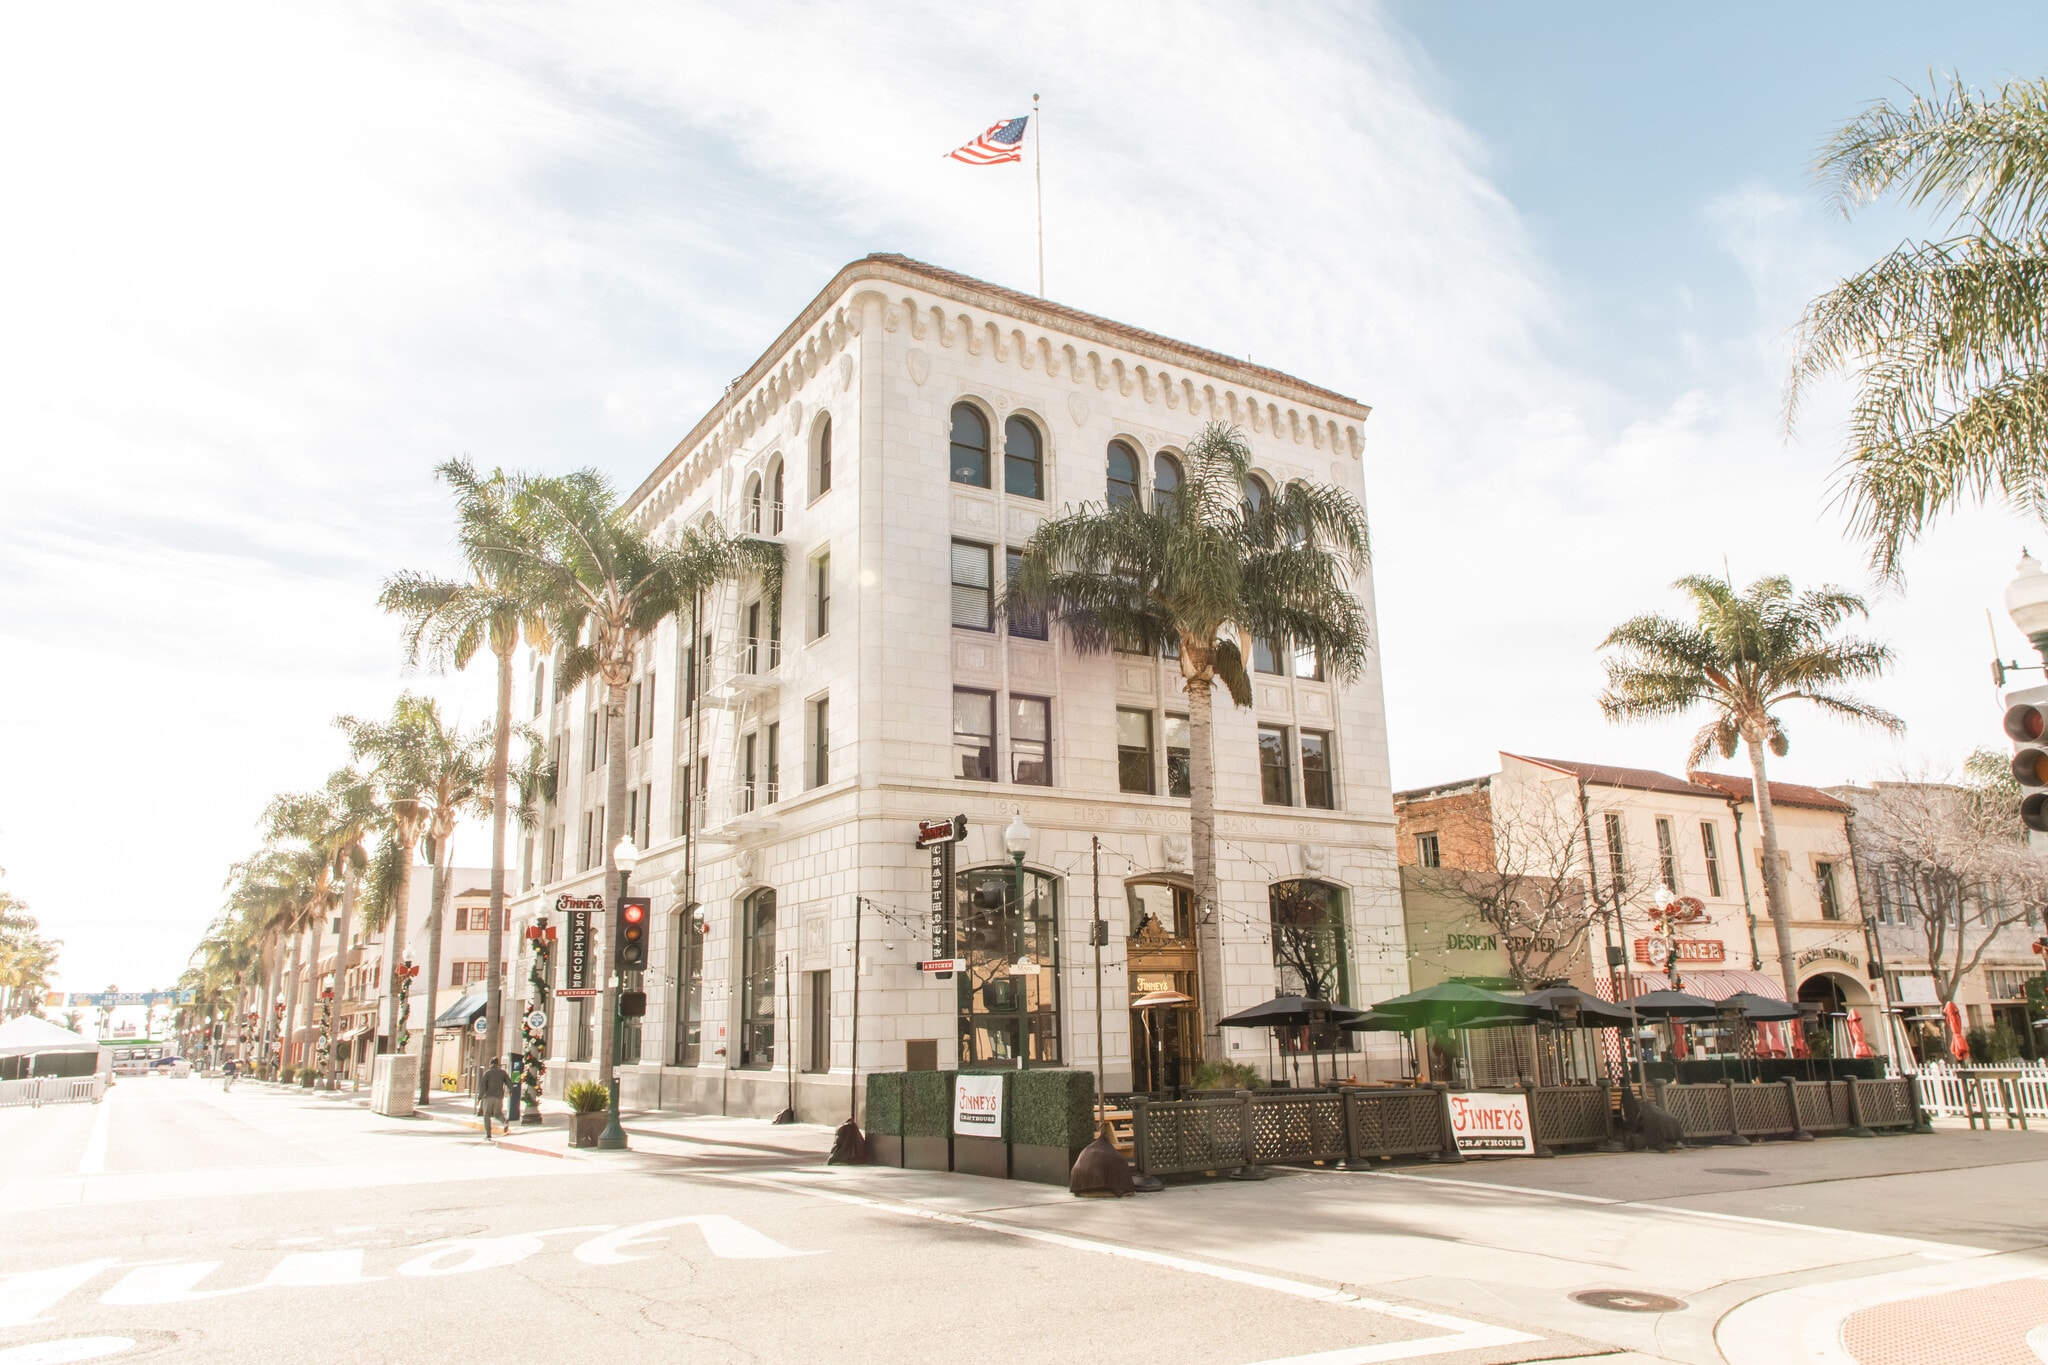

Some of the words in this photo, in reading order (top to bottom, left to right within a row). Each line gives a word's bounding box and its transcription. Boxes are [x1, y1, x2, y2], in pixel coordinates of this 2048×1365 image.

[994, 801, 1031, 816] 1904
[1075, 806, 1113, 823] FIRST
[1134, 811, 1191, 827] NATION
[1223, 817, 1258, 832] BANK
[561, 895, 603, 909] FINNEY'S
[932, 845, 942, 958] CRAFTHOUSE
[573, 912, 585, 988] CRAFTHOUSE
[1447, 934, 1497, 951] DESIGN
[1678, 943, 1720, 959] INER
[1137, 978, 1168, 991] FINNEY'S
[960, 1087, 997, 1111] FINNEY'S
[1451, 1097, 1523, 1131] FINNEY'S
